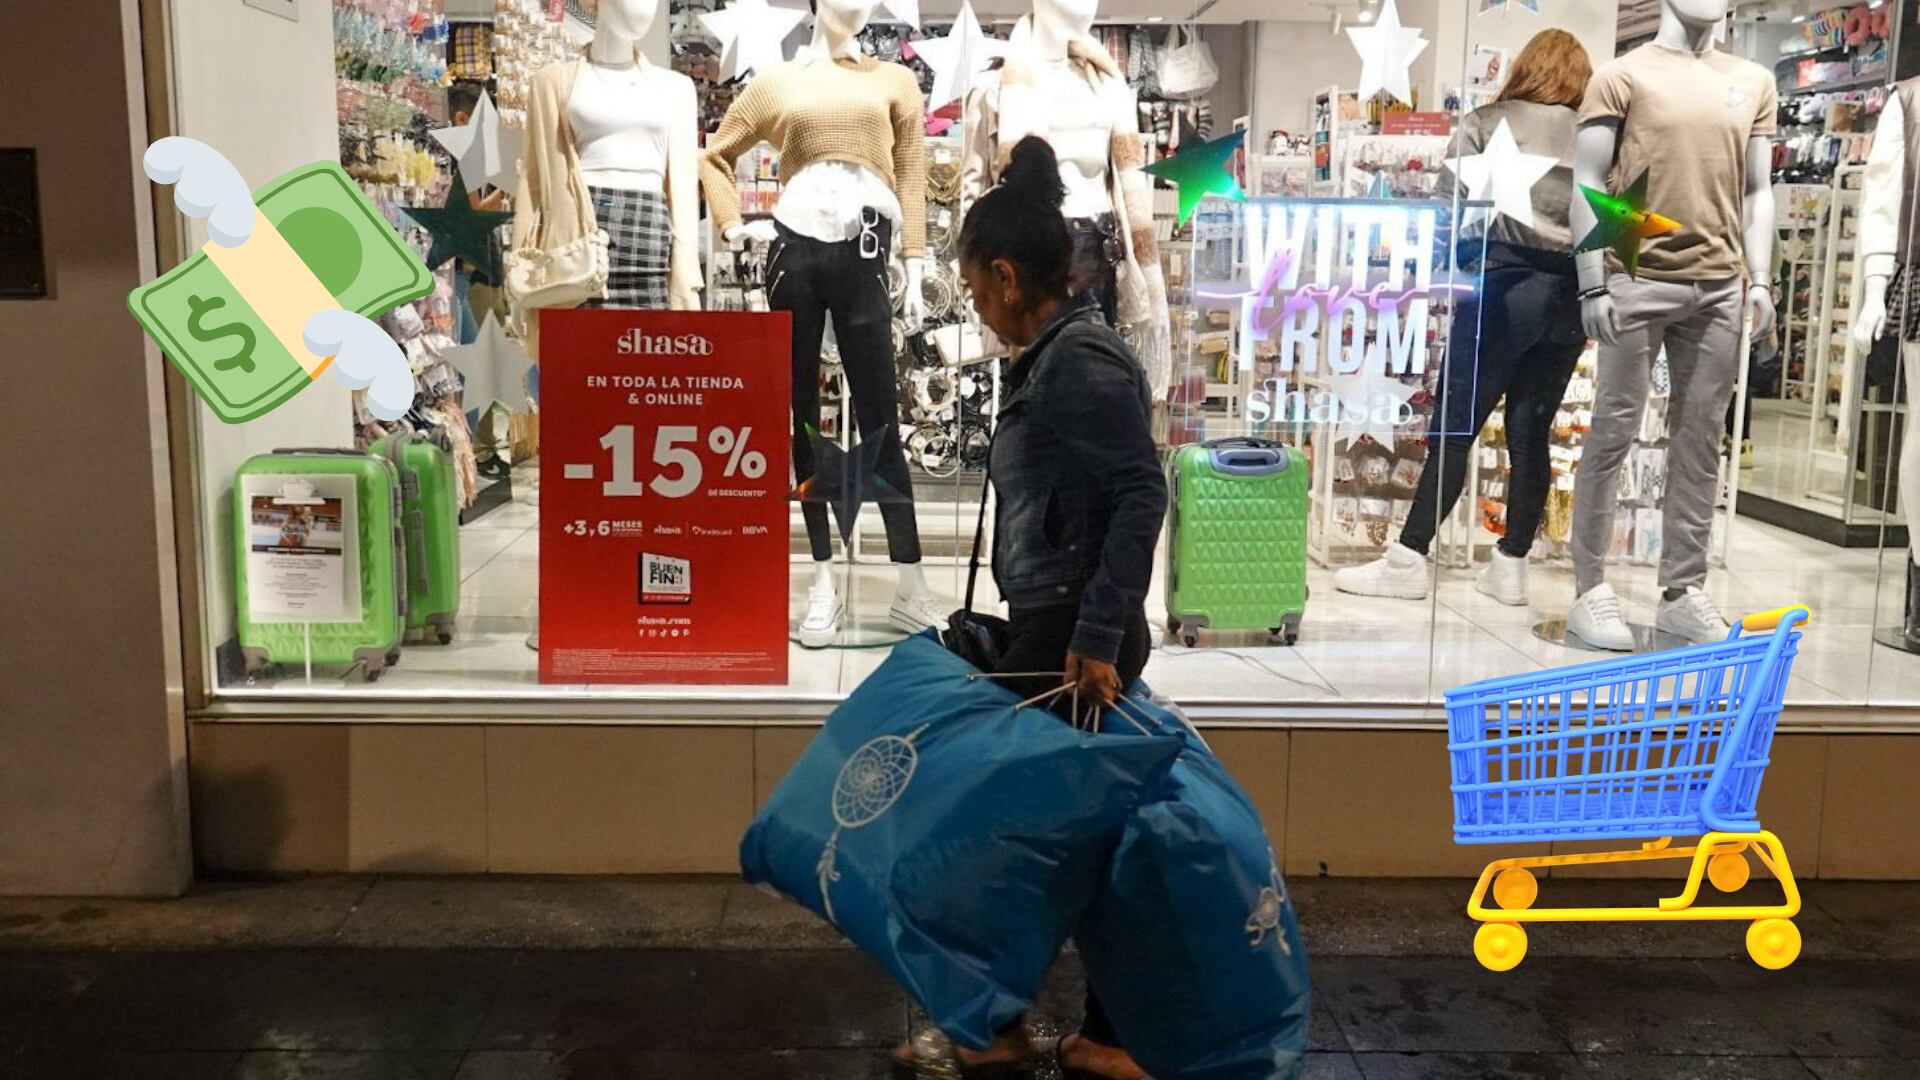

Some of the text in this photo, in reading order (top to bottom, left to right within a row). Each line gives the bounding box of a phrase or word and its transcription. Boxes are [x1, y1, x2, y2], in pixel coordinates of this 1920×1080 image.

[1244, 205, 1436, 292] WITH
[1197, 249, 1475, 332] love
[617, 328, 714, 355] shasa
[1239, 295, 1429, 375] FROM
[587, 375, 744, 389] EN TODA LA TIENDA
[628, 393, 703, 405] & ONLINE
[1246, 378, 1413, 425] shasa
[564, 425, 767, 498] -15%
[598, 520, 610, 536] 6
[650, 561, 683, 575] BUEN
